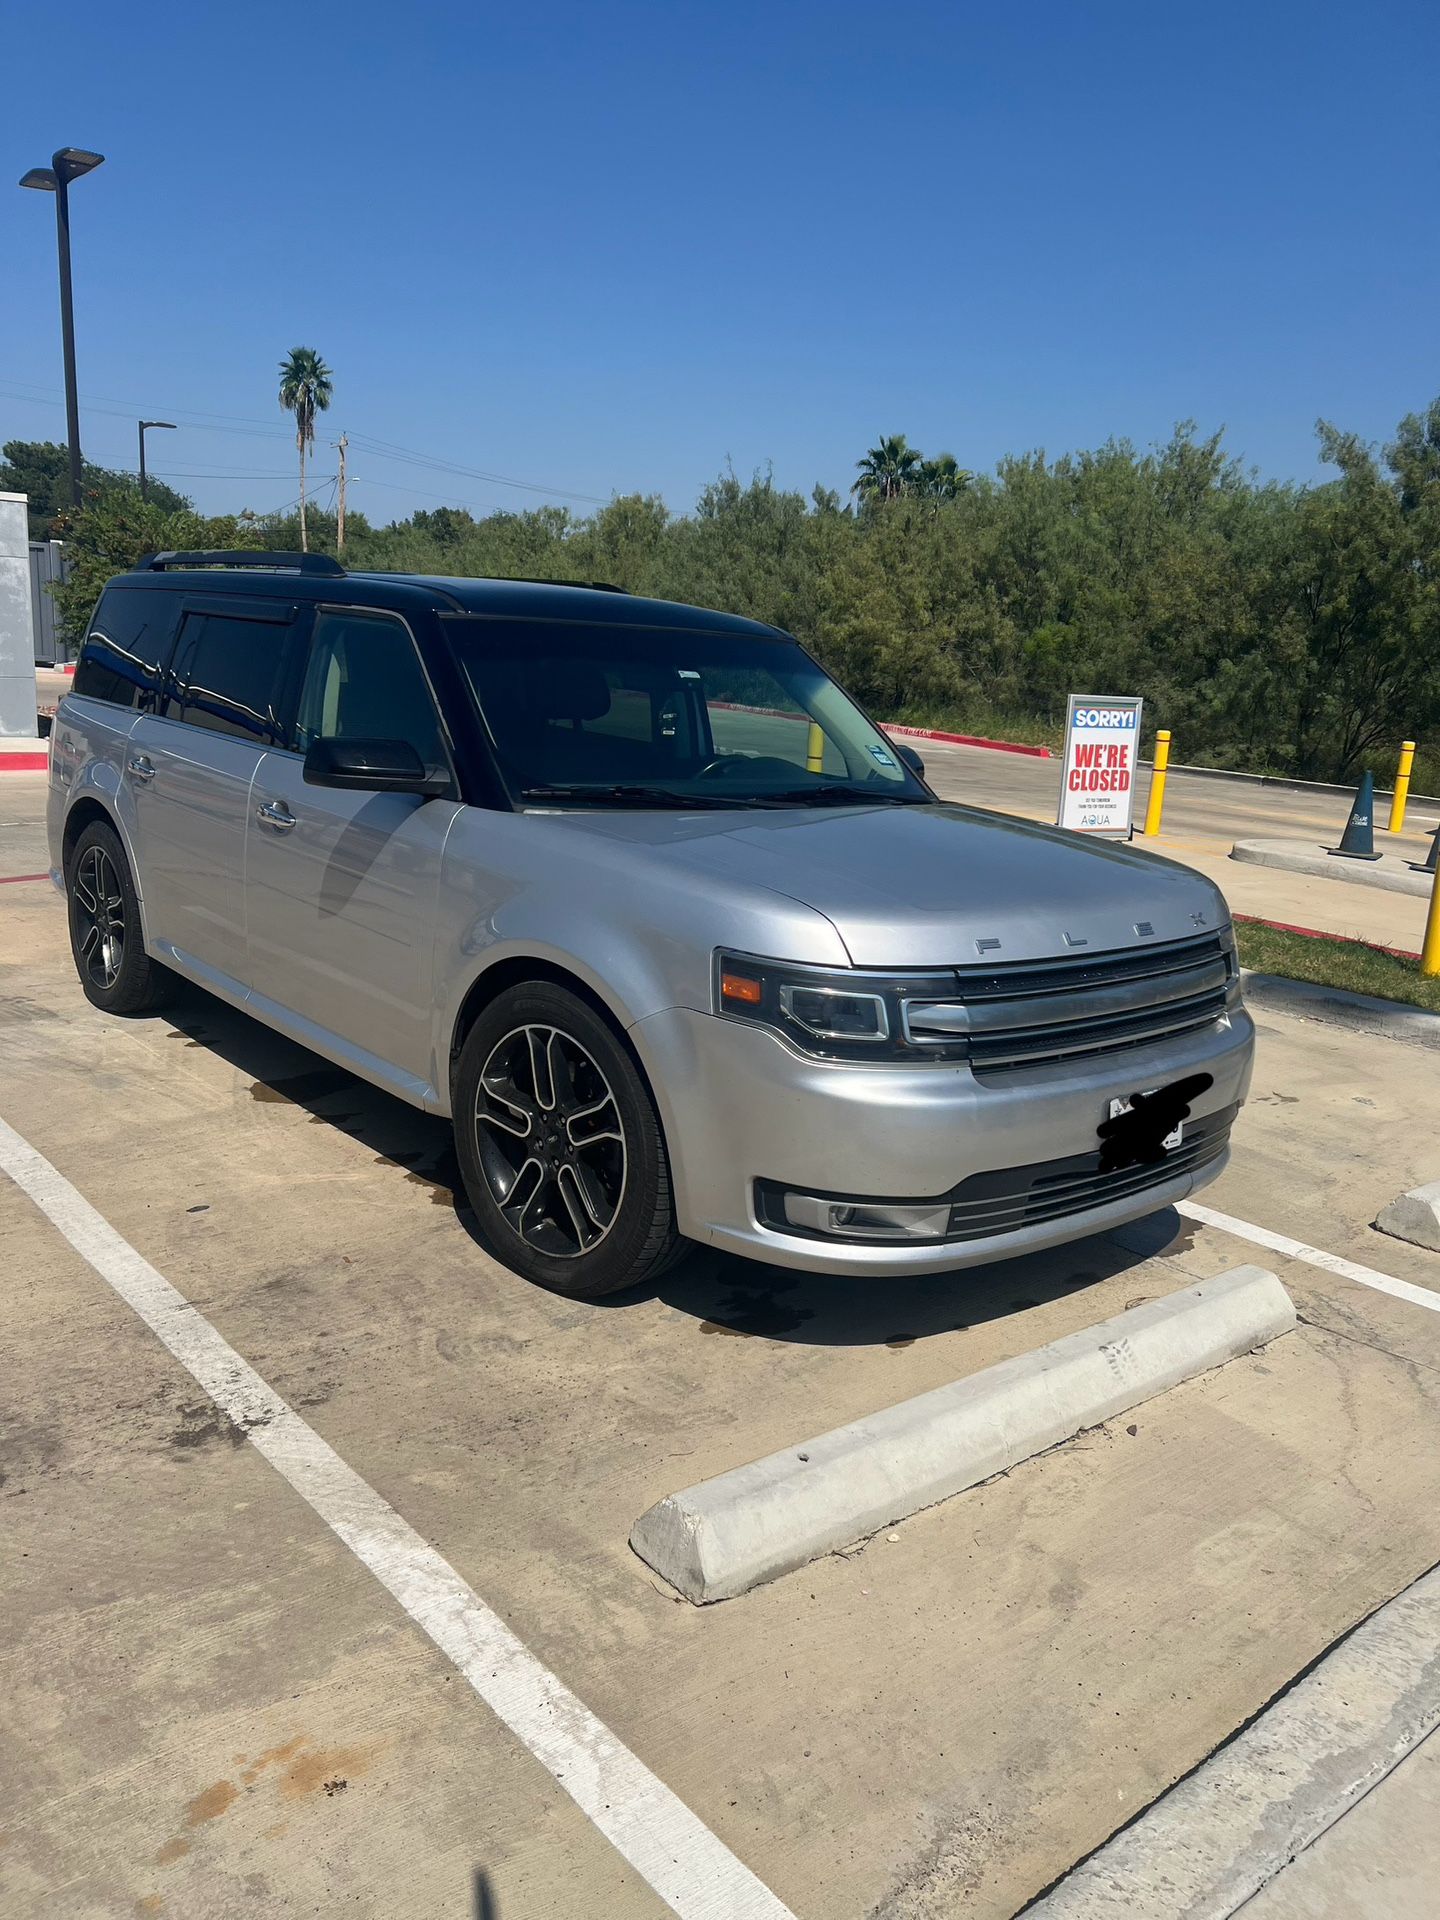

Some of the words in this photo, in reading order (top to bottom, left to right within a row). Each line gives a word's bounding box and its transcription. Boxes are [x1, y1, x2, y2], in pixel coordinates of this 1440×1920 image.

[1075, 709, 1134, 728] SORRY!
[1075, 744, 1129, 768] WE'RE
[1068, 769, 1130, 792] CLOSED
[1081, 814, 1110, 825] AQUA
[975, 911, 1207, 955] FLEX
